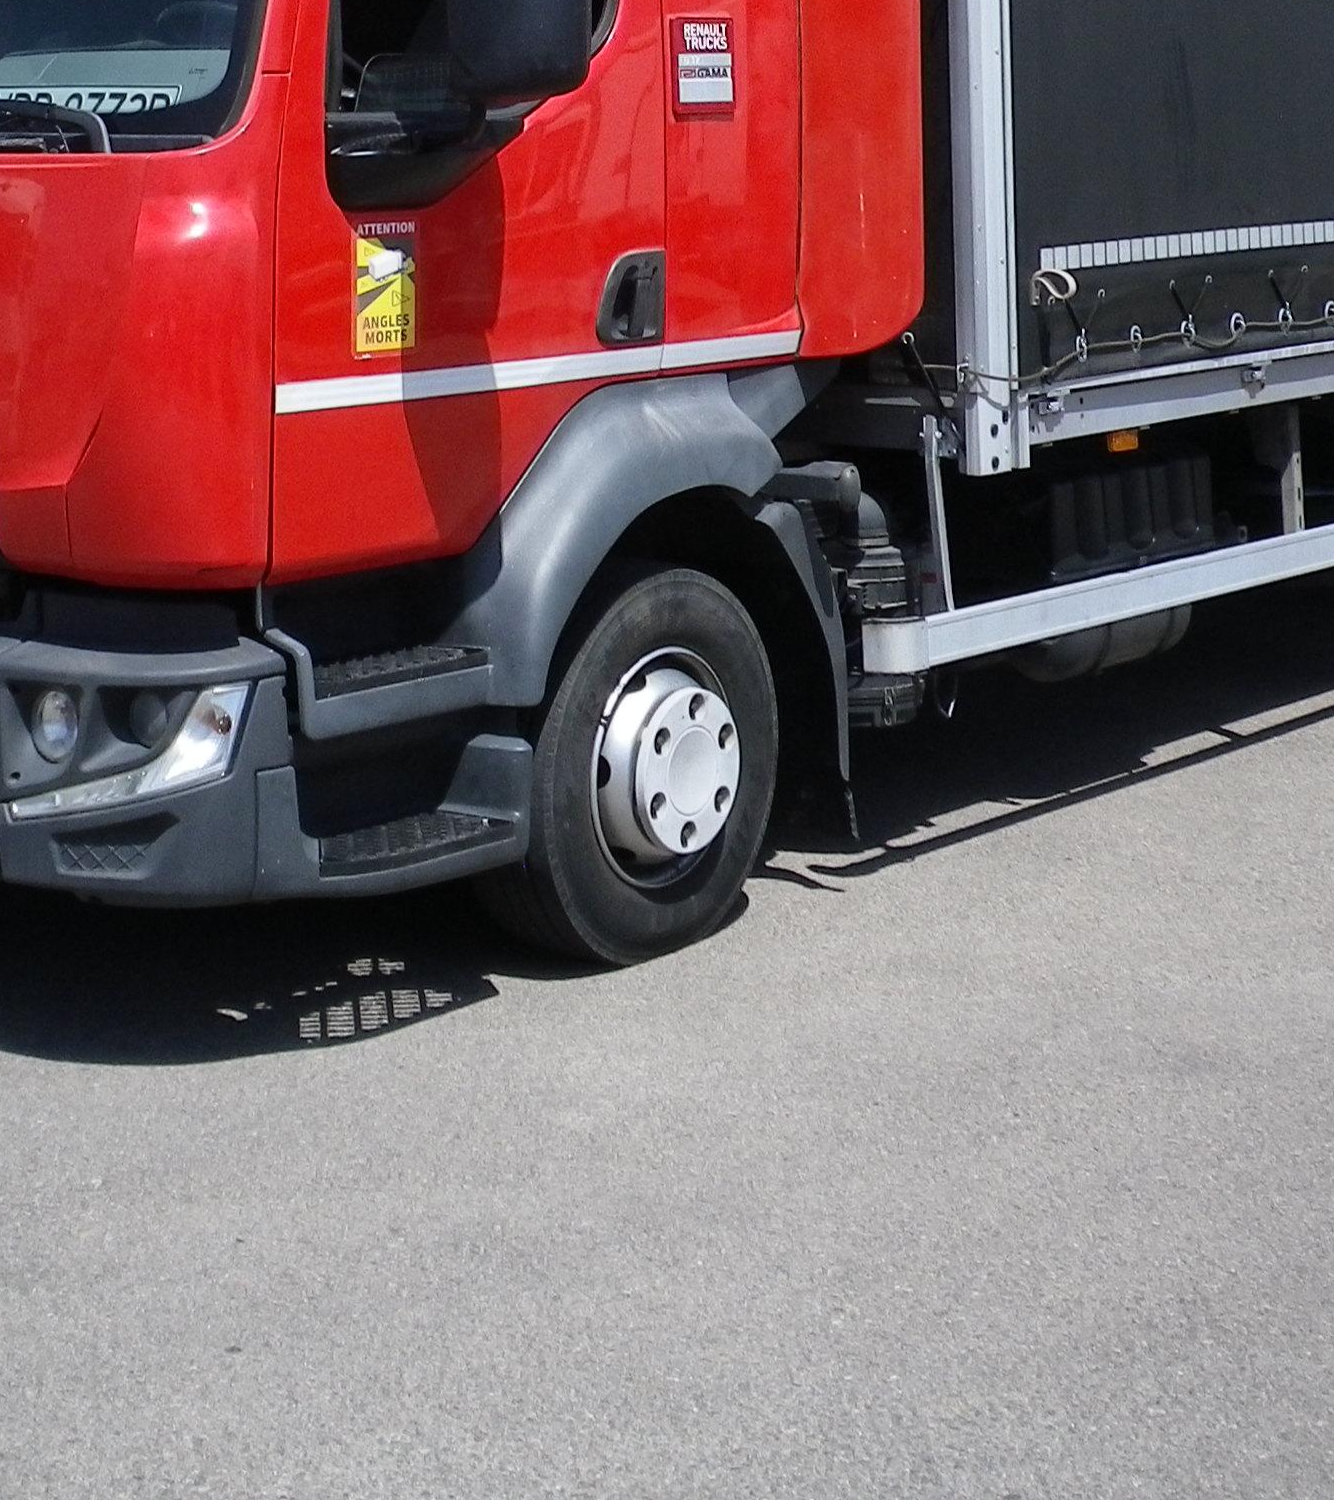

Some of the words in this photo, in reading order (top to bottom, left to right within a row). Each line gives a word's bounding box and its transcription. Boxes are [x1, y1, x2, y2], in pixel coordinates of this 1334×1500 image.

[683, 23, 727, 37] RENAULT
[684, 37, 728, 50] TRUCKS
[357, 221, 415, 235] ATTENTION
[363, 314, 410, 329] ANGLES
[365, 329, 407, 344] MORTS
